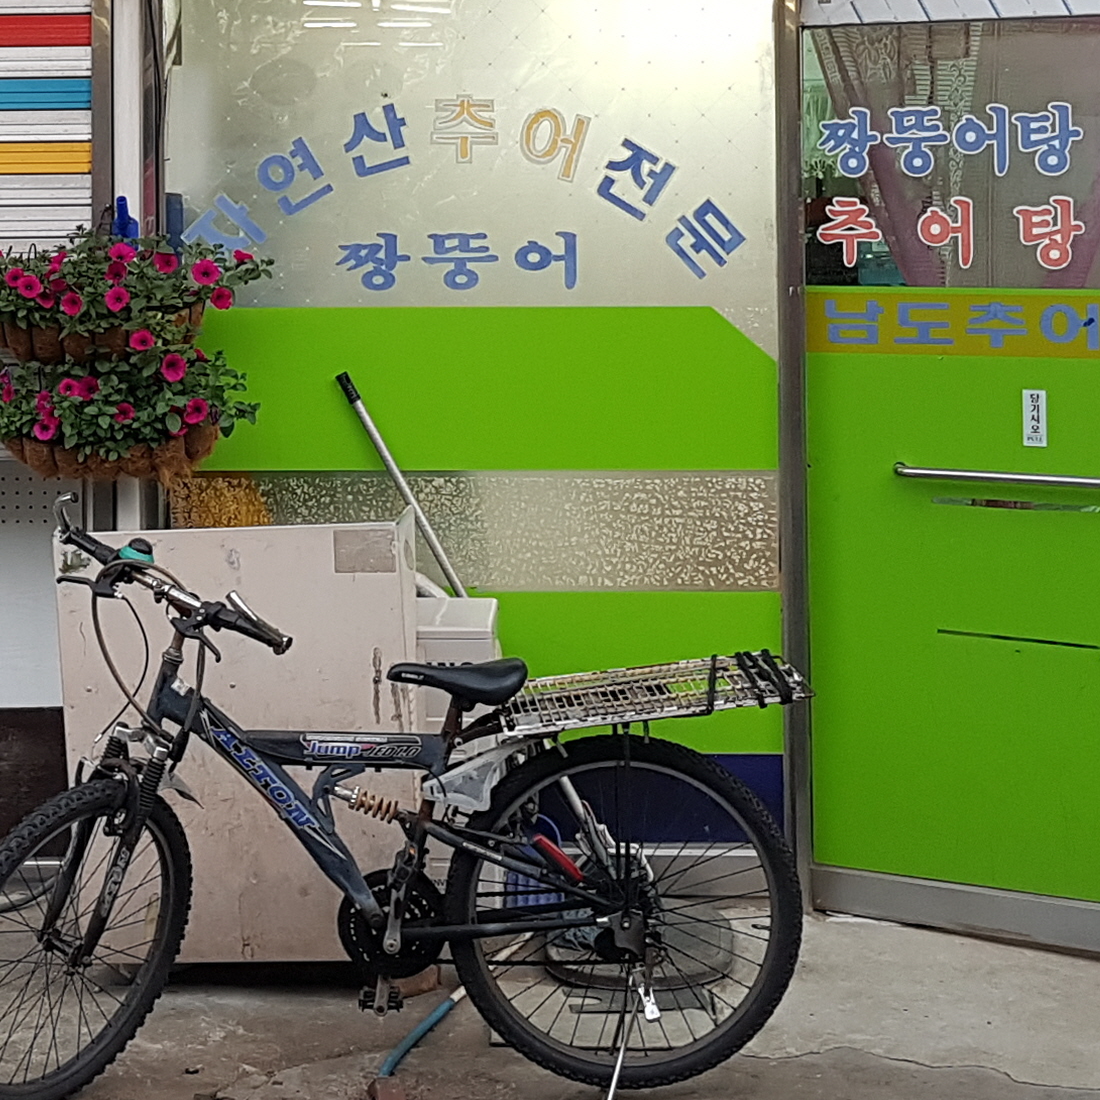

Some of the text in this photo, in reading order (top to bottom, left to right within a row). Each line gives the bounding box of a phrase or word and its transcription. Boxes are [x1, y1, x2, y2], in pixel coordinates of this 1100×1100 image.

[818, 102, 1083, 178] 짱뚱어탕
[336, 231, 578, 291] 짱뚱어
[210, 724, 318, 830] ALTON
